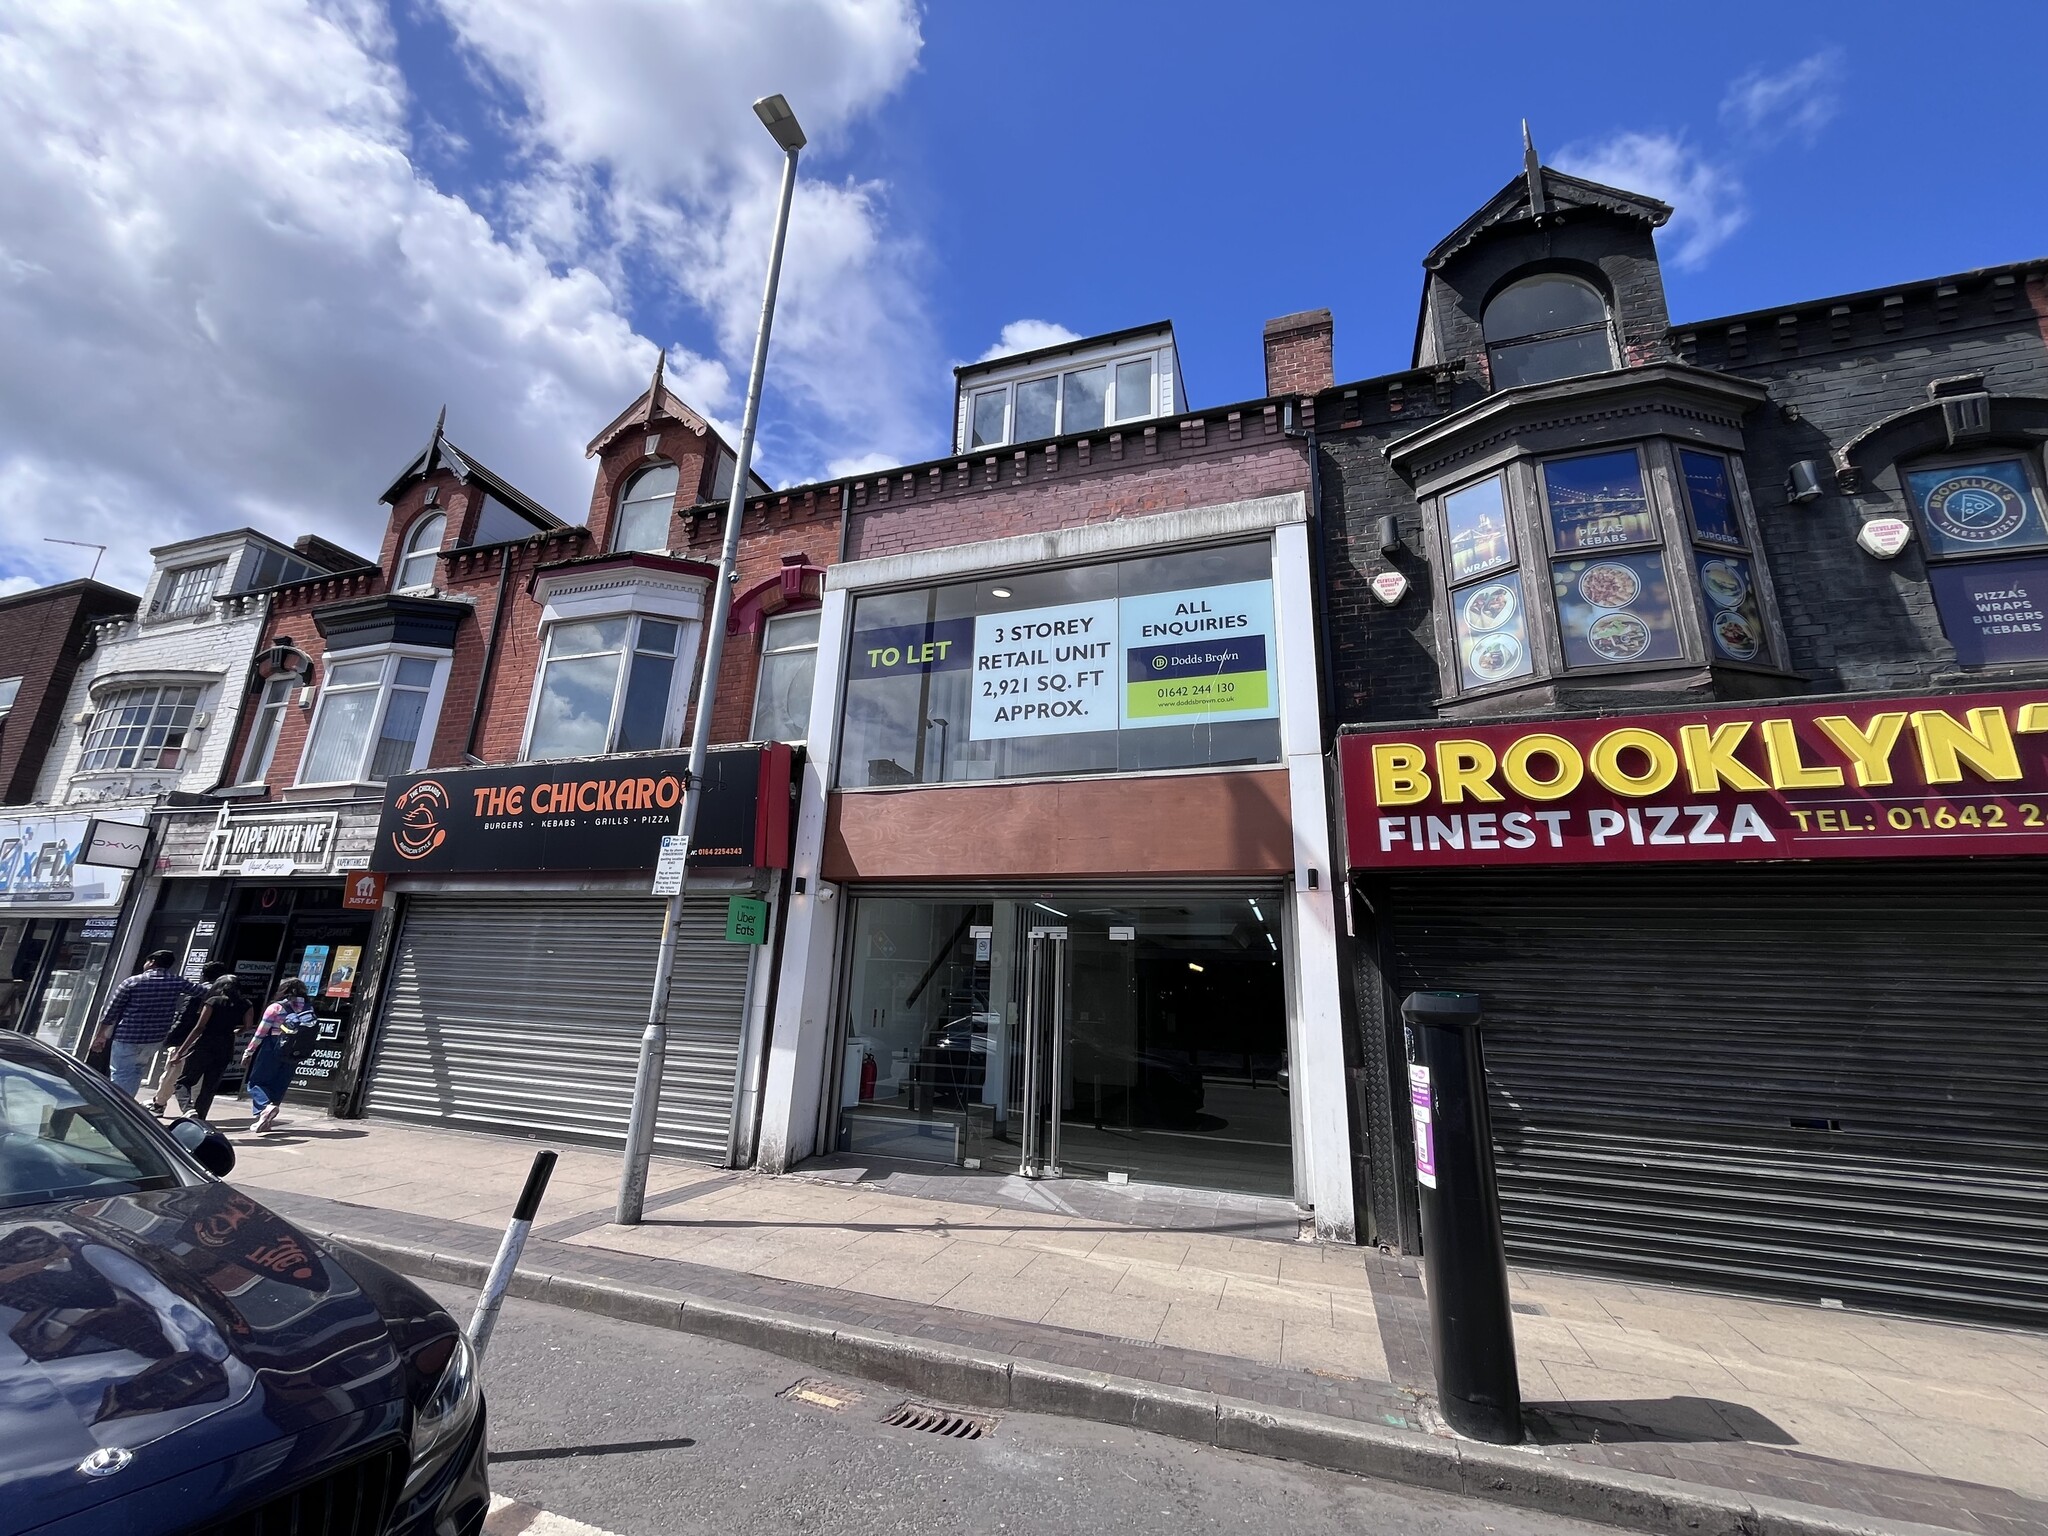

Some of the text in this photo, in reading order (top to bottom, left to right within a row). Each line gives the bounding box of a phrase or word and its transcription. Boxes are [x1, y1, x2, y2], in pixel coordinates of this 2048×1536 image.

[1930, 479, 2015, 508] BROOKLYN'S
[1579, 525, 1624, 537] PIZZAS
[1941, 515, 2019, 538] FINEST PIZZA
[1578, 533, 1628, 547] KEBABS
[1697, 529, 1739, 544] BURGERS
[1463, 555, 1502, 575] WRAPS
[1974, 589, 2027, 601] PIZZAS
[1175, 601, 1212, 616] ALL
[1976, 600, 2032, 612] WRAPS
[1972, 611, 2044, 624] BURGERS
[995, 617, 1094, 643] 3 STOREY
[1142, 614, 1248, 638] ENQUIRIES
[1982, 623, 2042, 635] KEBABS
[867, 641, 952, 668] TO LET
[978, 642, 1111, 671] RETAIL UNIT
[1171, 652, 1239, 666] Dodds Brown
[983, 670, 1104, 699] 2,921 SQ. FT
[1157, 682, 1235, 698] 01642 244 130
[1158, 696, 1235, 708] www.doddsbrown.co.uk
[994, 699, 1089, 723] APPROX.
[473, 785, 525, 817] THE
[484, 815, 670, 830] BURGERS KEBABS GRILLS PIZZA
[1790, 803, 2048, 832] TEL: 01642 2
[1378, 803, 1777, 852] FINEST PIZZA
[231, 824, 326, 853] VAPE WITH ME
[737, 911, 756, 924] Uber
[735, 923, 755, 936] Eats
[295, 1067, 329, 1078] CCESSORIES
